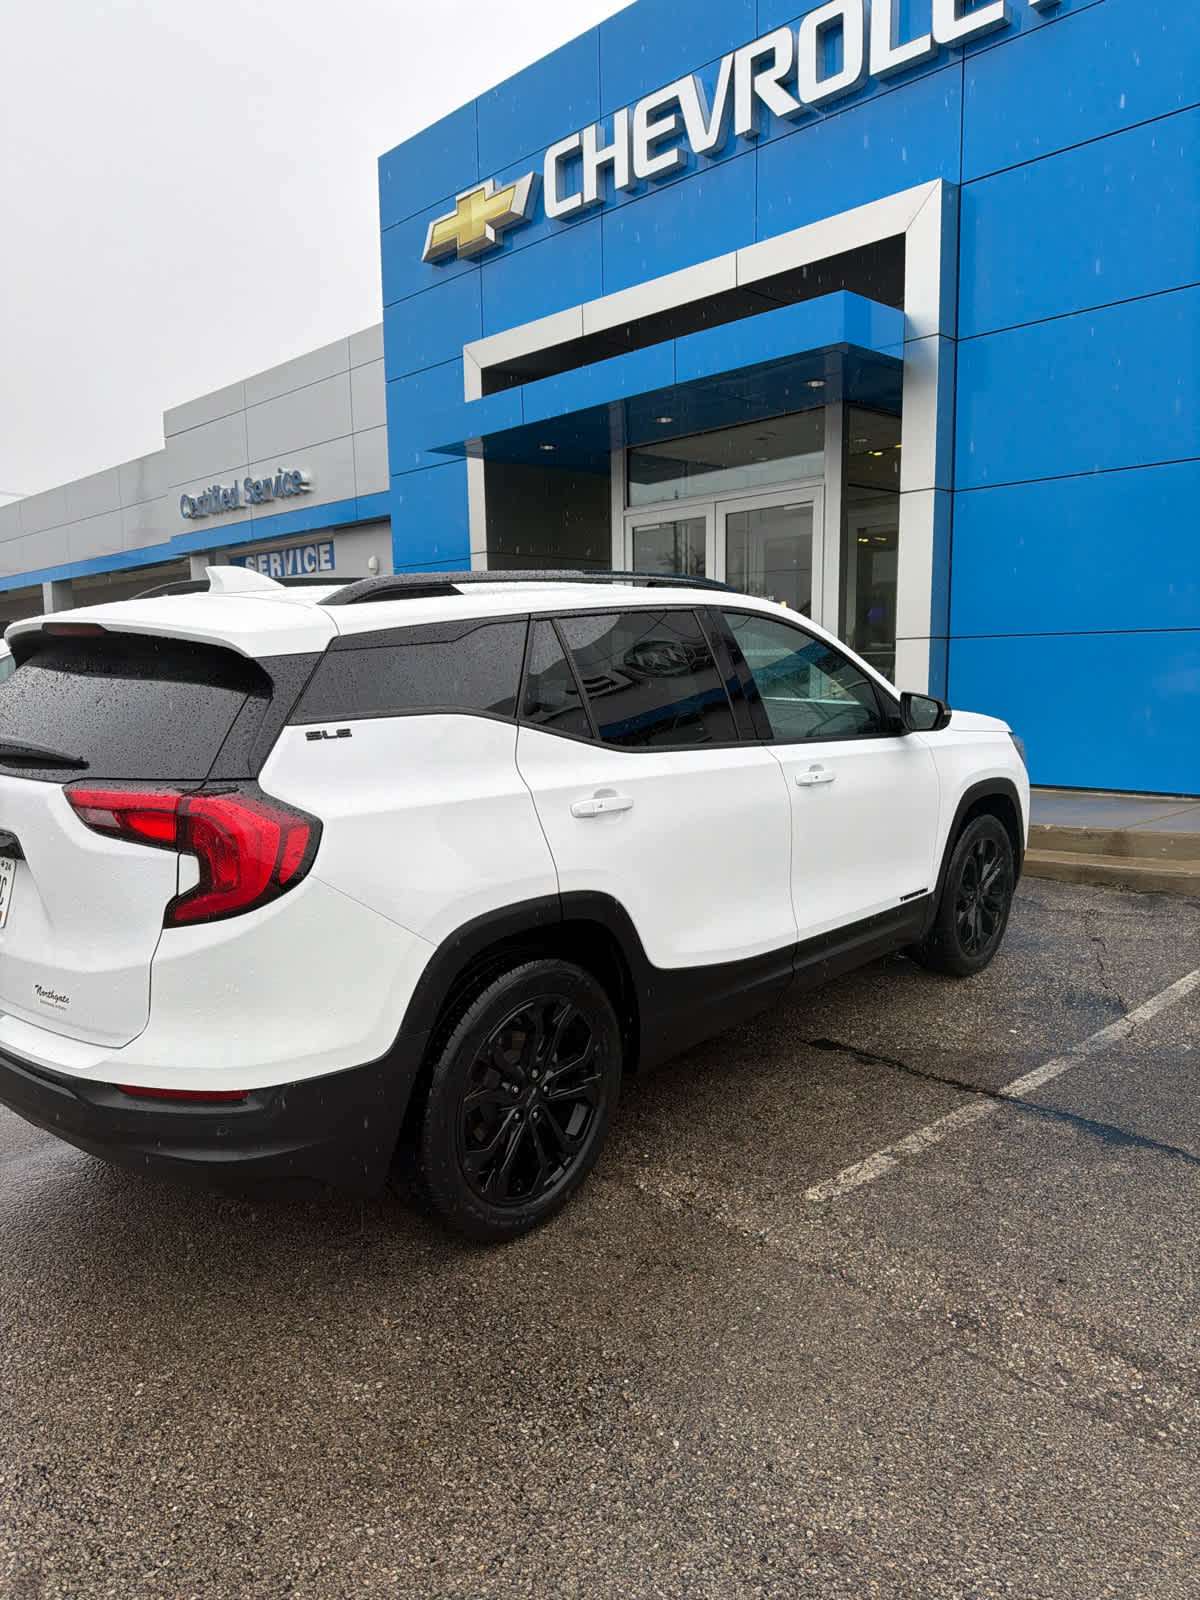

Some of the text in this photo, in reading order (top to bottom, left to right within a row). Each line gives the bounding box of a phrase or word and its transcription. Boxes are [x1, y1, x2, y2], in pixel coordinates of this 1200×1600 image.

[180, 467, 303, 519] Certified Service
[305, 728, 352, 741] SLE
[34, 984, 70, 1004] Northgate
